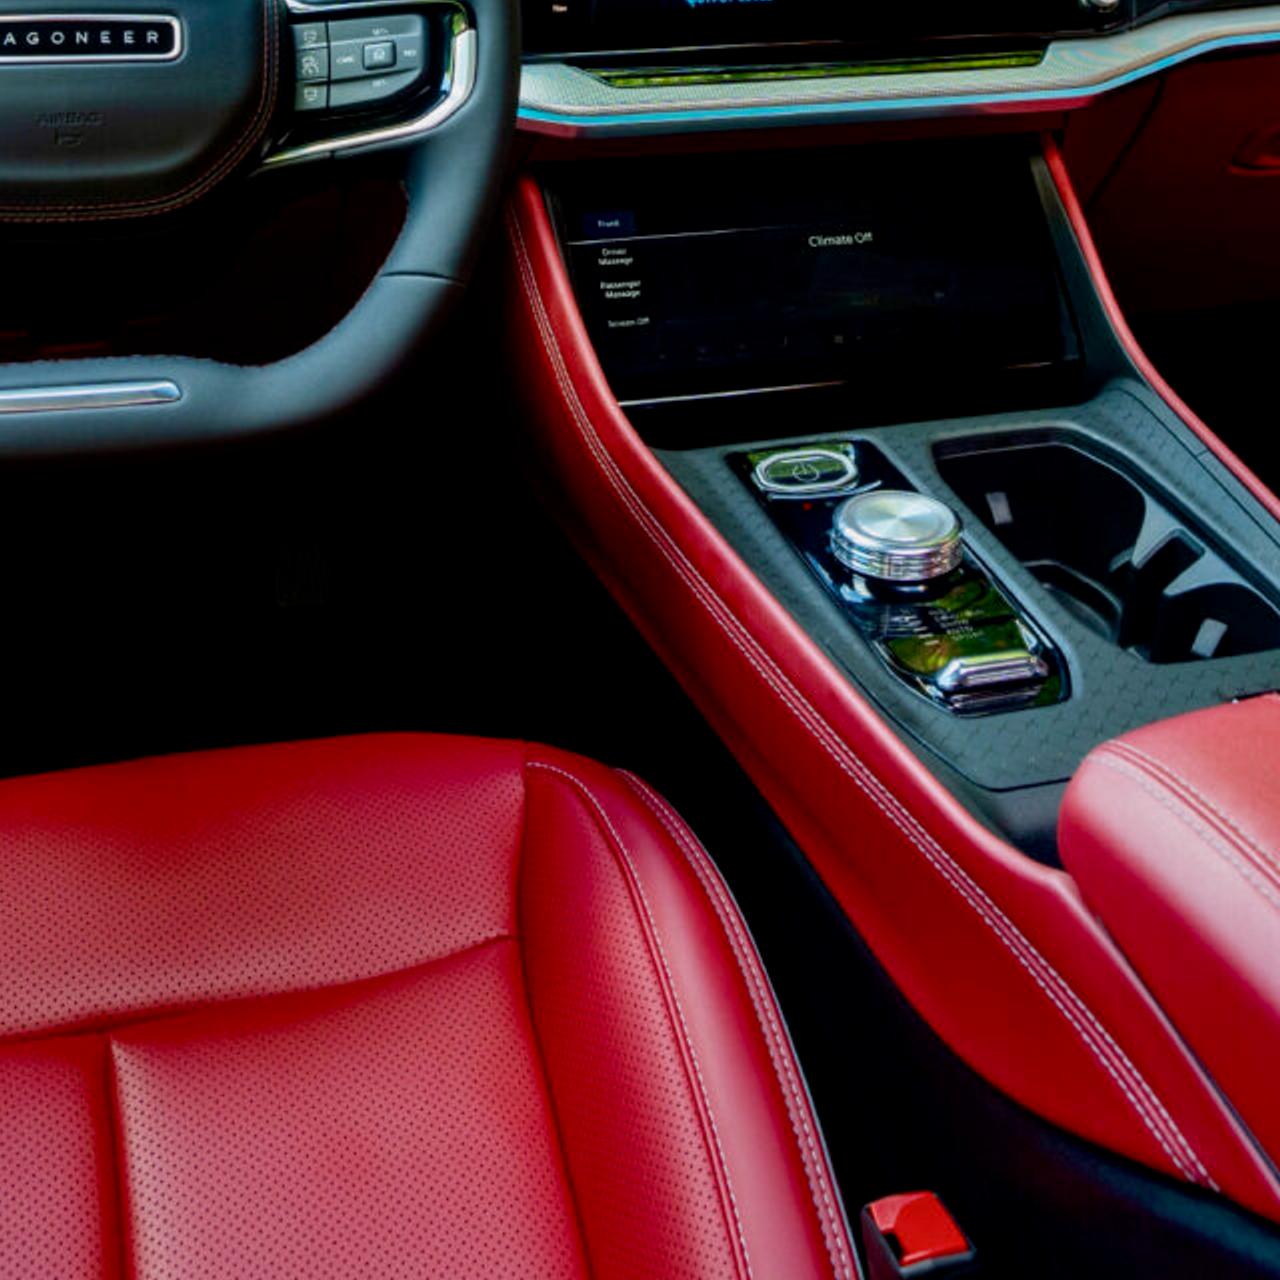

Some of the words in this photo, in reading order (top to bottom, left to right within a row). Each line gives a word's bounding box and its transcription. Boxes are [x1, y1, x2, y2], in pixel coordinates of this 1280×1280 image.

[808, 235, 853, 247] Climate
[854, 232, 872, 243] Off
[598, 258, 633, 266] Massage
[600, 281, 641, 290] Passenger
[605, 290, 641, 299] Massage
